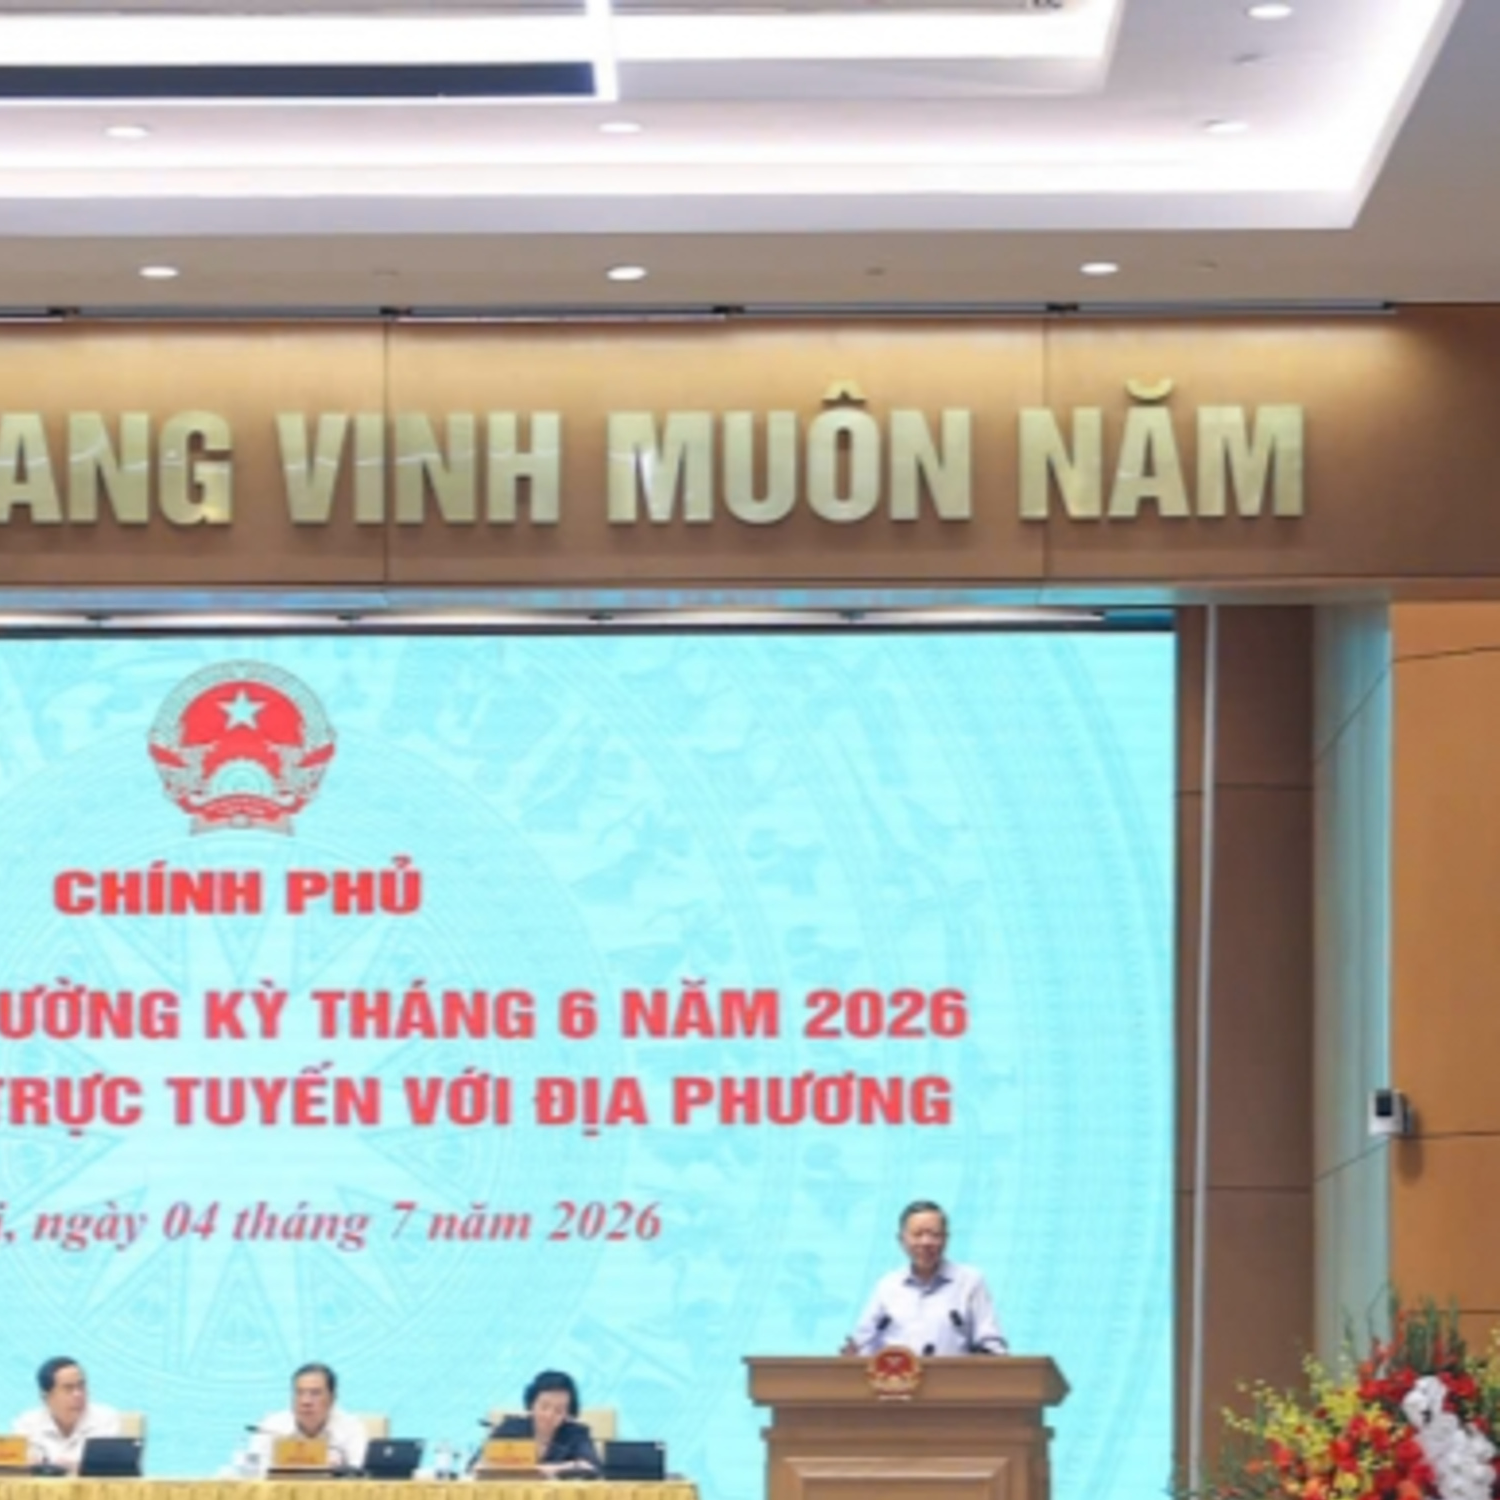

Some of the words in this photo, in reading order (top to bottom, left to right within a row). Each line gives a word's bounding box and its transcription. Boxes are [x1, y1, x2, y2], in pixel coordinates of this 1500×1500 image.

[277, 411, 561, 525] VINH
[607, 380, 972, 525] MUÔN
[1018, 377, 1305, 521] NĂM
[53, 860, 262, 916] CHÍNH
[286, 854, 422, 916] PHỦ
[205, 979, 289, 1040] KỲ
[311, 978, 537, 1040] THÁNG
[558, 989, 599, 1040] 6
[621, 978, 781, 1040] NĂM
[802, 989, 969, 1040] 2026
[166, 1062, 381, 1127] TUYẾN
[404, 1066, 512, 1127] VỚI
[534, 1077, 650, 1137] ĐỊA
[671, 1072, 952, 1127] PHƯƠNG
[32, 1202, 148, 1252] ngày
[162, 1201, 220, 1241] 04
[232, 1201, 370, 1251] tháng
[391, 1201, 417, 1241] 7
[427, 1203, 532, 1241] năm
[547, 1201, 662, 1241] 2026
